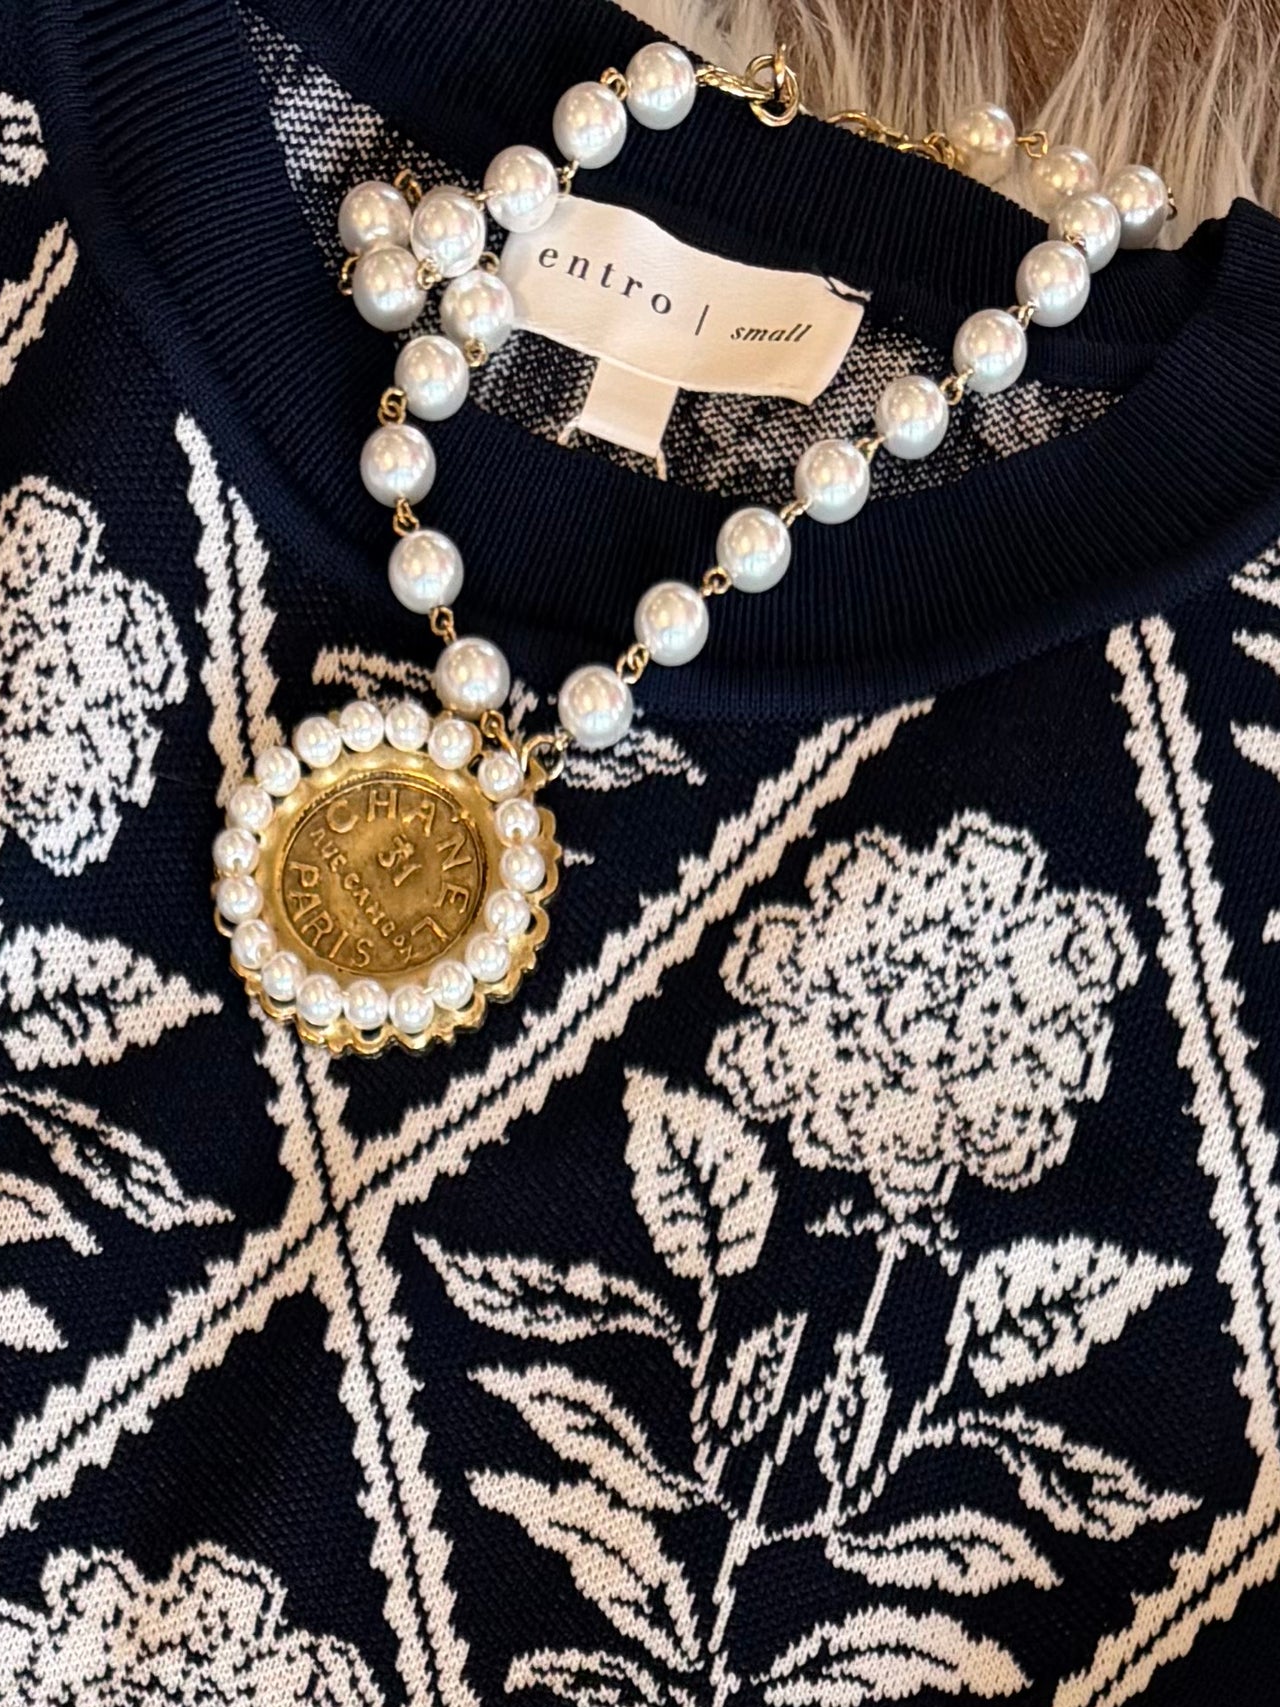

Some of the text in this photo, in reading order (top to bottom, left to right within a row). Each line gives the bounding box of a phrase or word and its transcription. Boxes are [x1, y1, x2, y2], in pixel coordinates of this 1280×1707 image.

[537, 245, 813, 344] entro small
[326, 789, 472, 942] CHANEL
[377, 834, 423, 887] 31
[288, 861, 375, 968] PARIS
